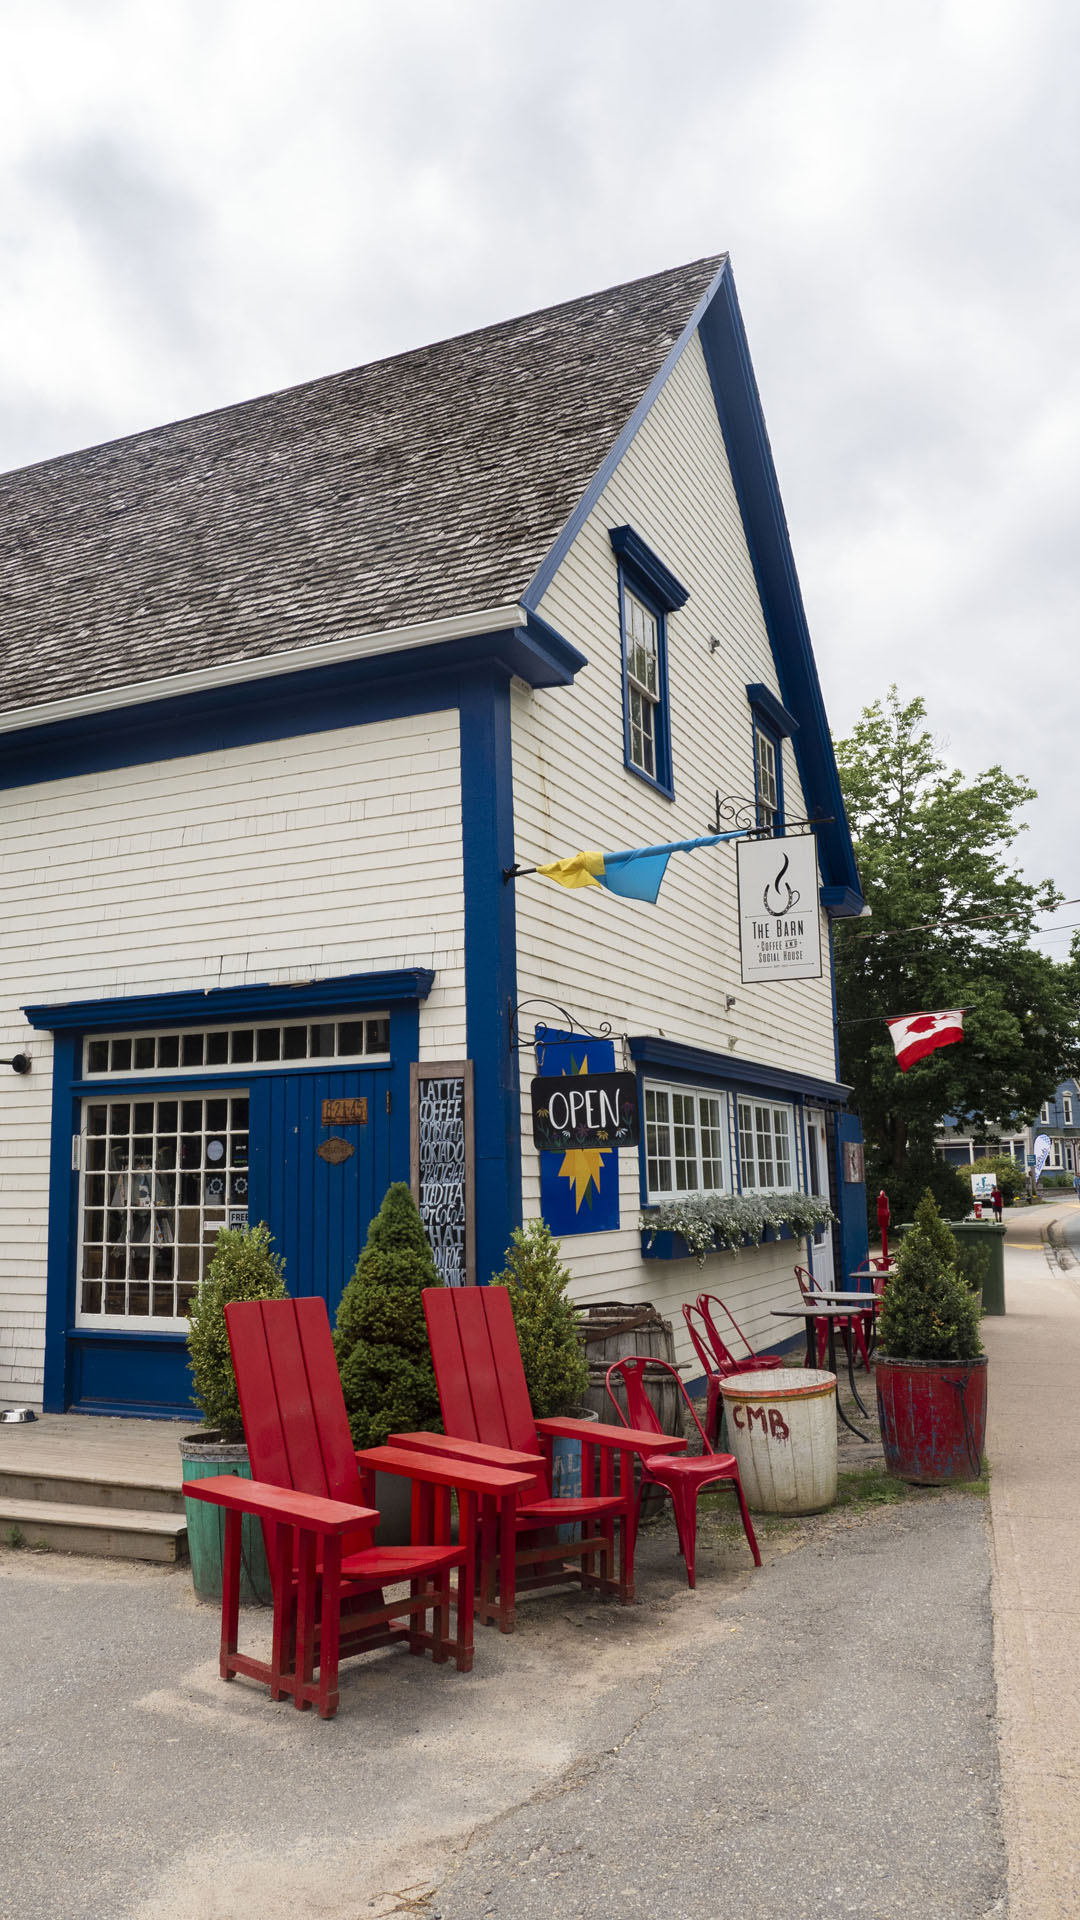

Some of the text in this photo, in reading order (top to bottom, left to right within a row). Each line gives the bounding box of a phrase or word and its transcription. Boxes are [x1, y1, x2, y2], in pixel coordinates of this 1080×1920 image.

[752, 920, 804, 939] THE BARN
[761, 941, 782, 951] COFFEE
[758, 951, 803, 963] SOCIAL HOUSE
[420, 1079, 464, 1100] LATTE
[420, 1100, 462, 1122] COFFEE
[548, 1088, 620, 1130] OPEN
[420, 1142, 465, 1162] CORTADO
[420, 1183, 464, 1206] ICED TEA
[436, 1203, 465, 1226] COCOA
[733, 1405, 789, 1440] CMB
